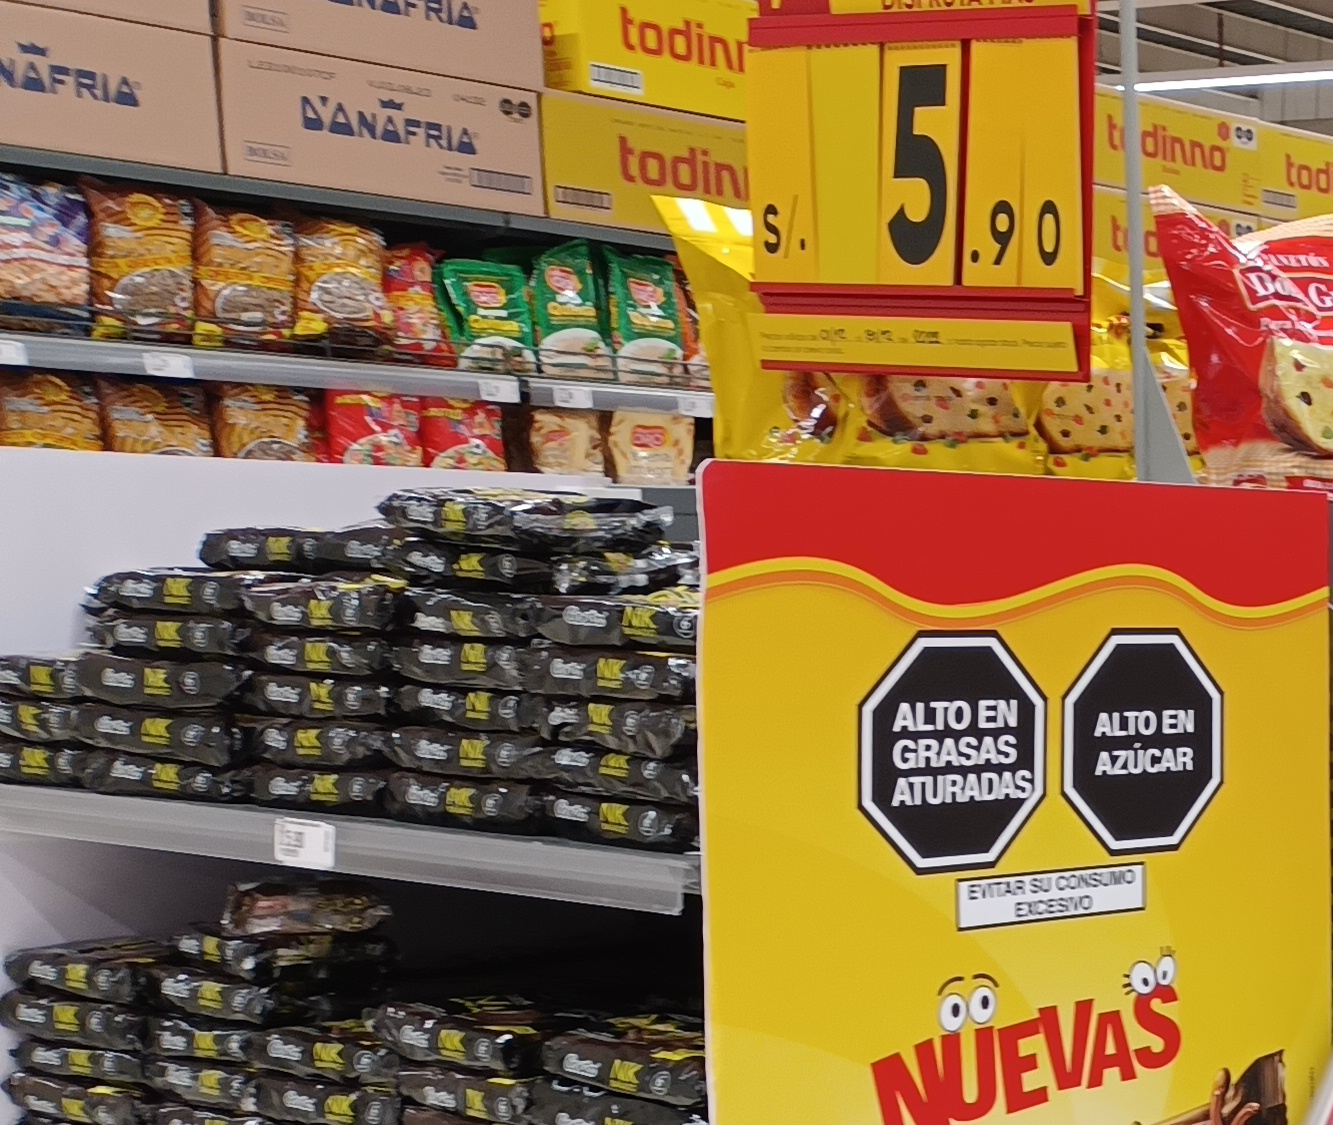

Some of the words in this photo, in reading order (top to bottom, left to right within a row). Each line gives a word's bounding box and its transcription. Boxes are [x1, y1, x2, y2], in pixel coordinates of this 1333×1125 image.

[888, 64, 947, 267] 5
[893, 700, 972, 732] ALTO
[978, 699, 1018, 729] EN
[1094, 711, 1157, 737] ALTO
[1162, 709, 1195, 734] EN
[892, 735, 1018, 770] GRASAS
[1094, 742, 1195, 776] AZÚCAR
[891, 771, 1034, 806] ATURADAS
[966, 878, 1026, 901] EVITAR
[1030, 875, 1053, 895] SU
[1056, 867, 1137, 892] CONSUMO
[1013, 894, 1094, 919] EXCESIVO
